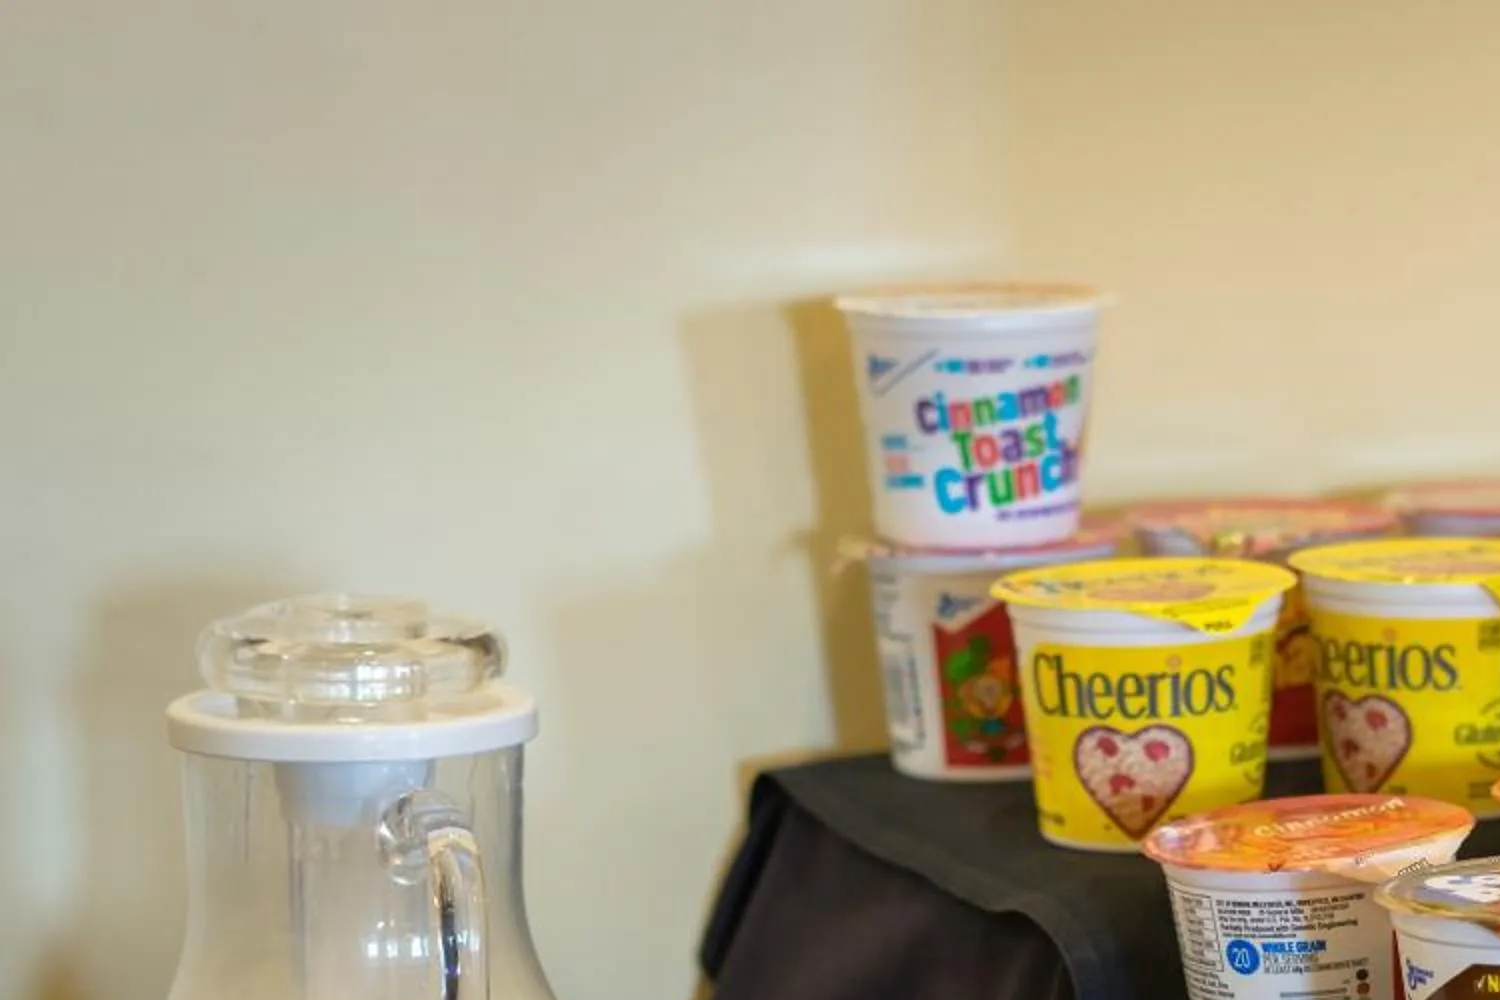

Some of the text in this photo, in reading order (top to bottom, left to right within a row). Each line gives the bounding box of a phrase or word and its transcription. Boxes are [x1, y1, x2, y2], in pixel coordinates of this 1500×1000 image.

[952, 411, 1057, 471] Toast
[1033, 652, 1237, 720] Cheerios
[1318, 627, 1459, 691] eerios
